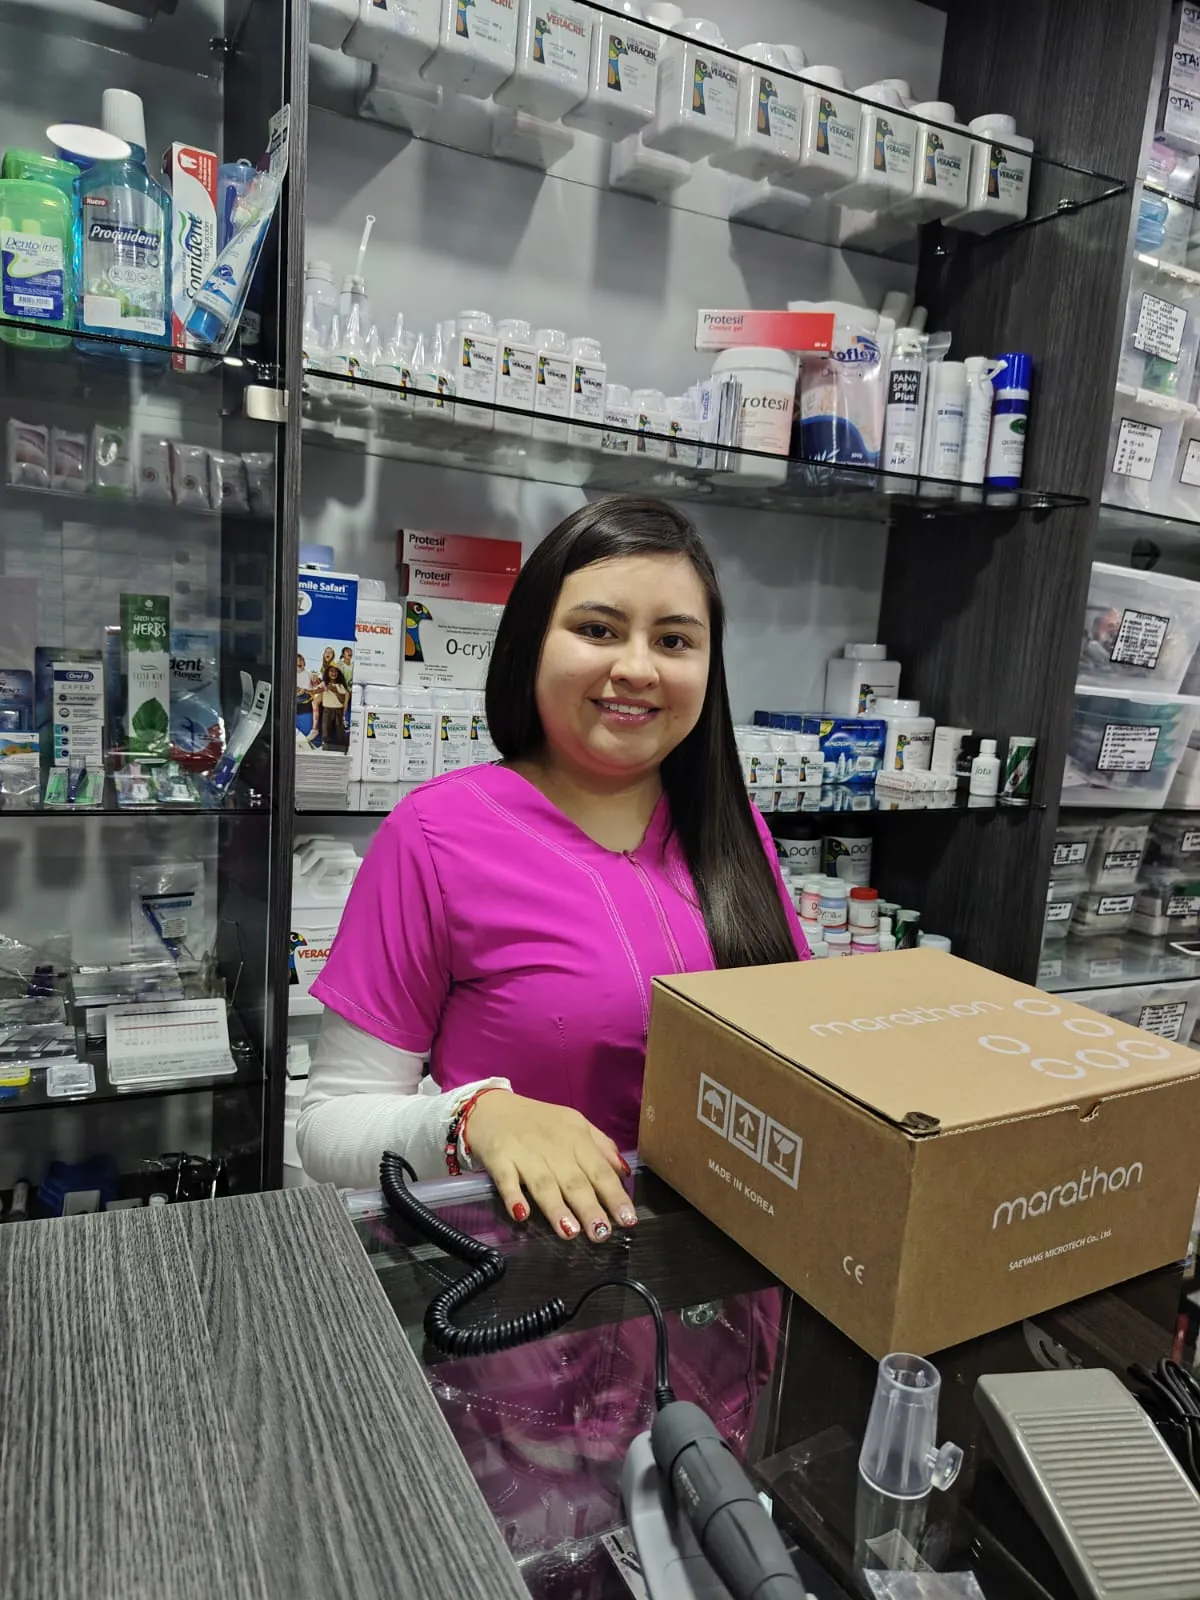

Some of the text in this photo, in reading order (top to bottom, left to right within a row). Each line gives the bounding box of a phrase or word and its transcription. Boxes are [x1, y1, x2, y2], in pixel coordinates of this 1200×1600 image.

[546, 12, 587, 38] VERACRIL
[626, 42, 657, 61] VERACRIL
[91, 225, 158, 247] Proquident
[704, 313, 744, 325] Protesil
[893, 374, 918, 382] PANA
[892, 383, 917, 392] SPRAY
[895, 392, 915, 401] Plus
[408, 533, 445, 546] Protesil
[415, 569, 451, 581] Protesil
[319, 582, 346, 593] Safari
[133, 622, 166, 637] HERBS
[975, 767, 992, 776] jota
[808, 1000, 1004, 1037] marathon
[708, 1158, 775, 1216] MADE IN KOREA
[992, 1161, 1143, 1230] marathon
[1008, 1251, 1045, 1271] SAEYANG
[1044, 1237, 1086, 1259] MICROTECH
